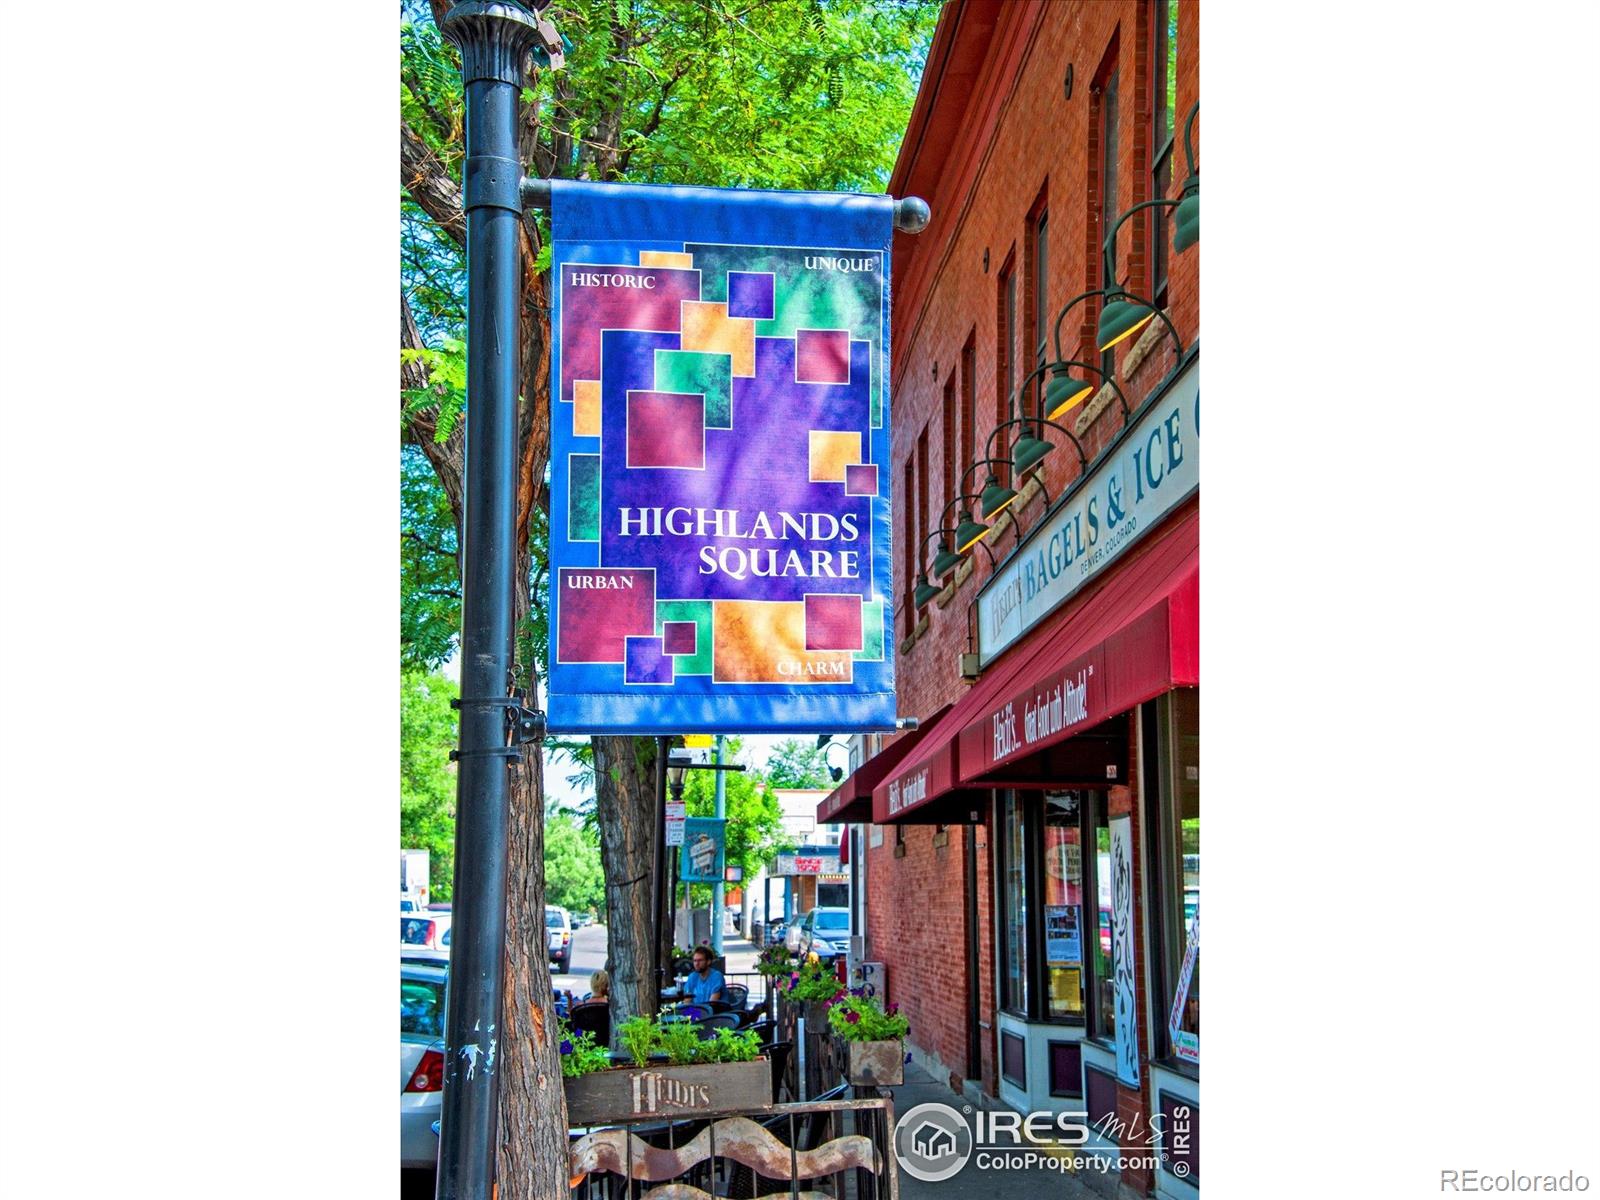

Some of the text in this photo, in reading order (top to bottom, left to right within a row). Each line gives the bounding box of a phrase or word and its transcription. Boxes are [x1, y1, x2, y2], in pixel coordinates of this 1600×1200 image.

[571, 272, 656, 290] HISTORIC
[804, 256, 874, 274] UNIQUE
[1025, 495, 1099, 603] BAGELS
[1107, 474, 1126, 530] &
[1133, 408, 1184, 505] ICE
[618, 506, 860, 542] HIGHLANDS
[1106, 516, 1137, 555] COLORADO
[699, 545, 860, 581] SQUARE
[567, 575, 634, 590] URBAN
[777, 660, 845, 676] CHARM
[1038, 690, 1050, 740] Food
